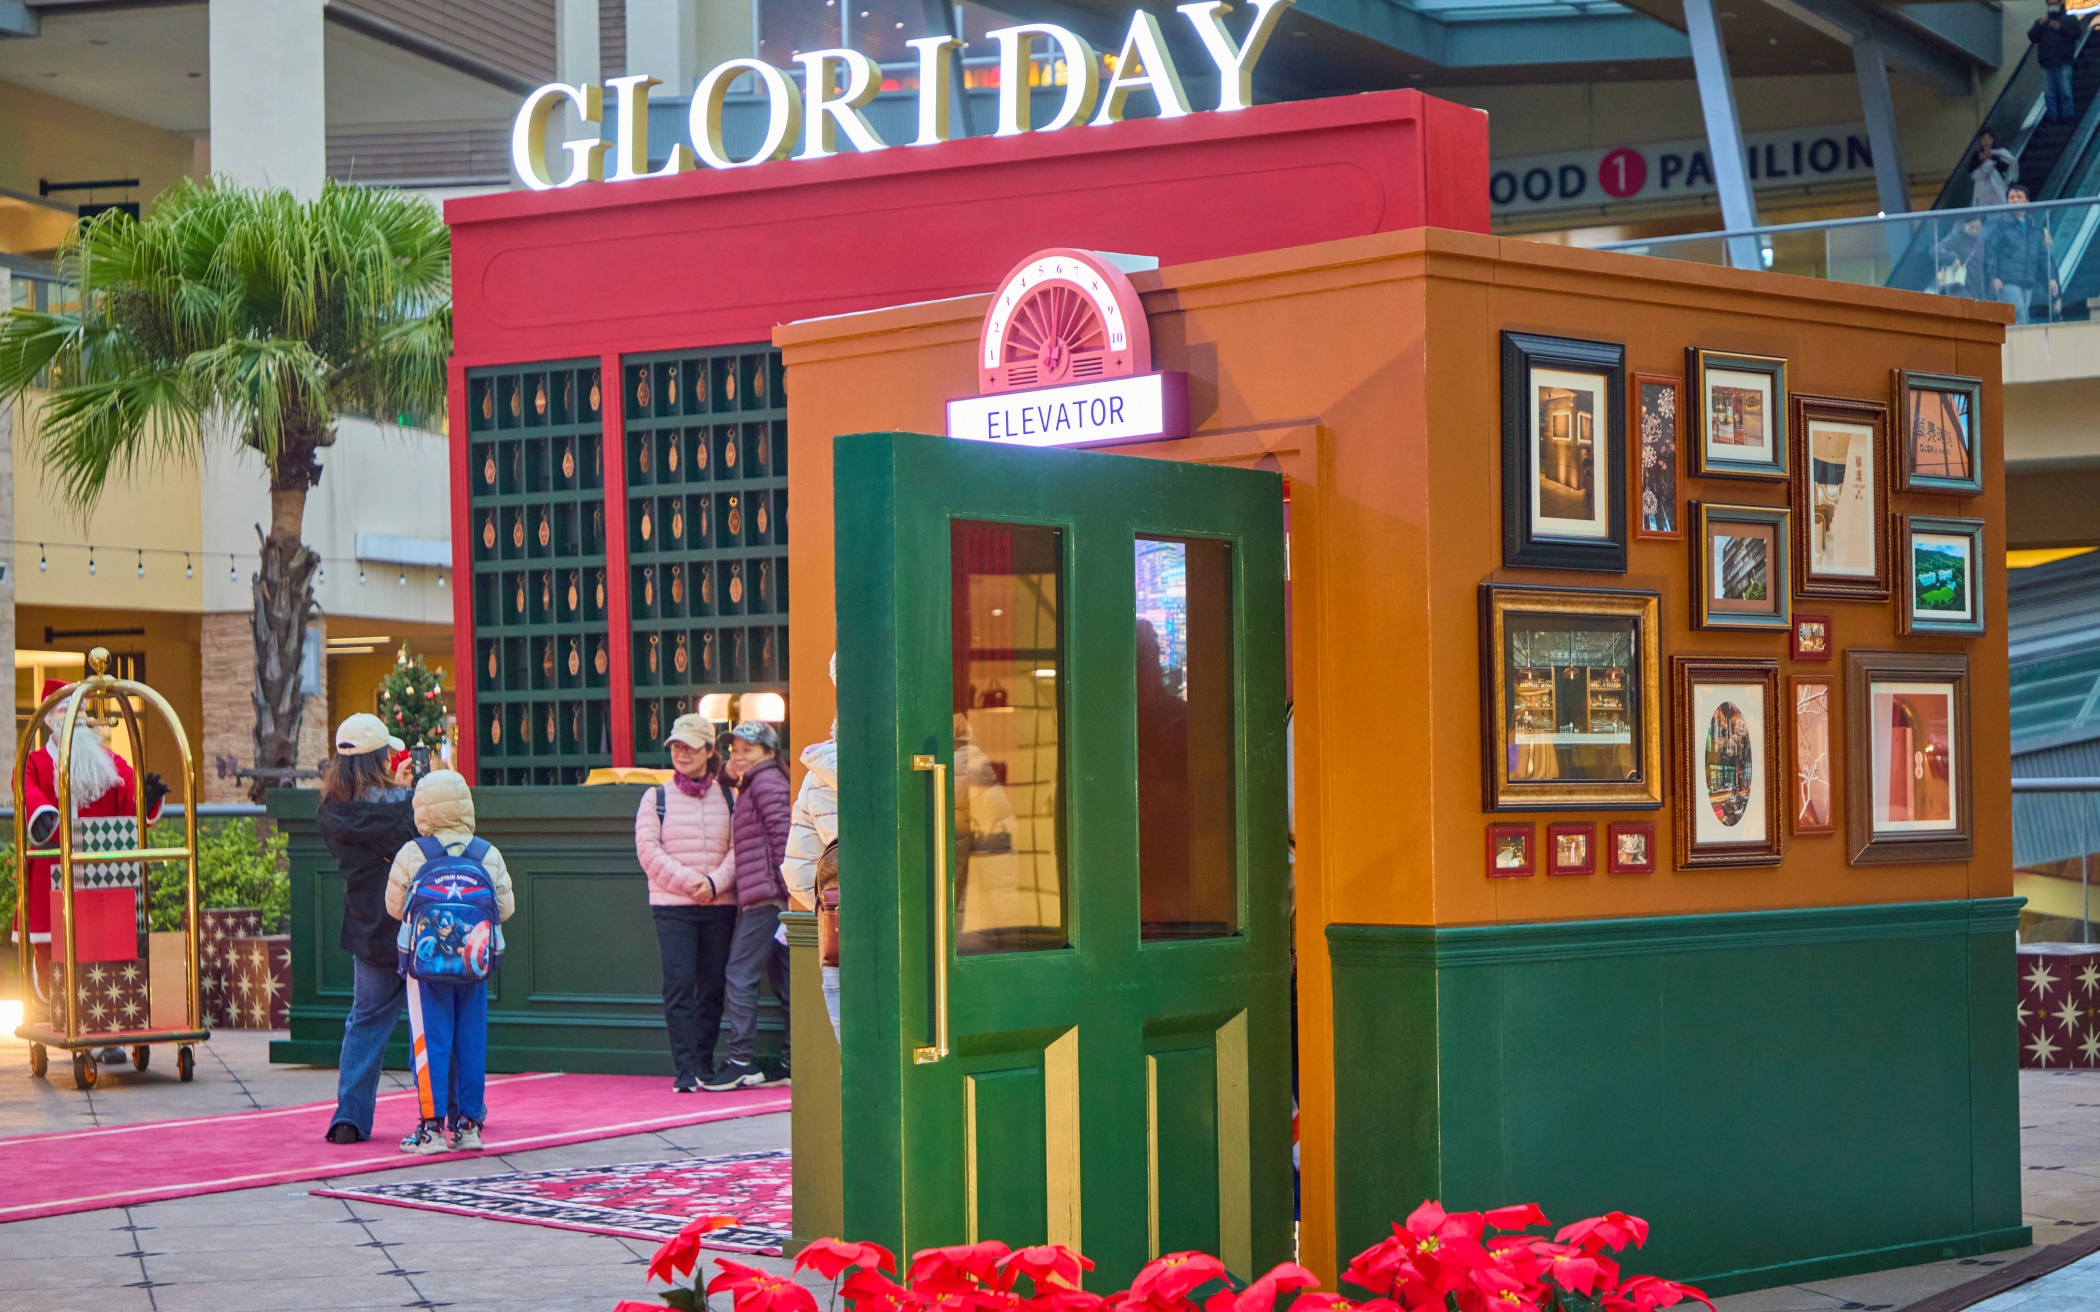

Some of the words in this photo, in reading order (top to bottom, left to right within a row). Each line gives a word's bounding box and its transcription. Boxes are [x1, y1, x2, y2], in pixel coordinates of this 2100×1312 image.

[1489, 164, 1587, 205] OOD
[1659, 134, 1873, 189] PAILION
[990, 350, 994, 361] 1
[994, 322, 1000, 333] 2
[1005, 297, 1010, 308] 3
[1020, 277, 1026, 288] 4
[1038, 265, 1044, 277] 5
[1056, 263, 1062, 275] 6
[1073, 266, 1079, 277] 7
[1092, 280, 1098, 291] 8
[1107, 305, 1114, 316] 9
[1111, 332, 1123, 344] 10
[987, 395, 1125, 439] ELEVATOR
[434, 874, 456, 885] CAPTAIN
[456, 874, 478, 886] AMERICA
